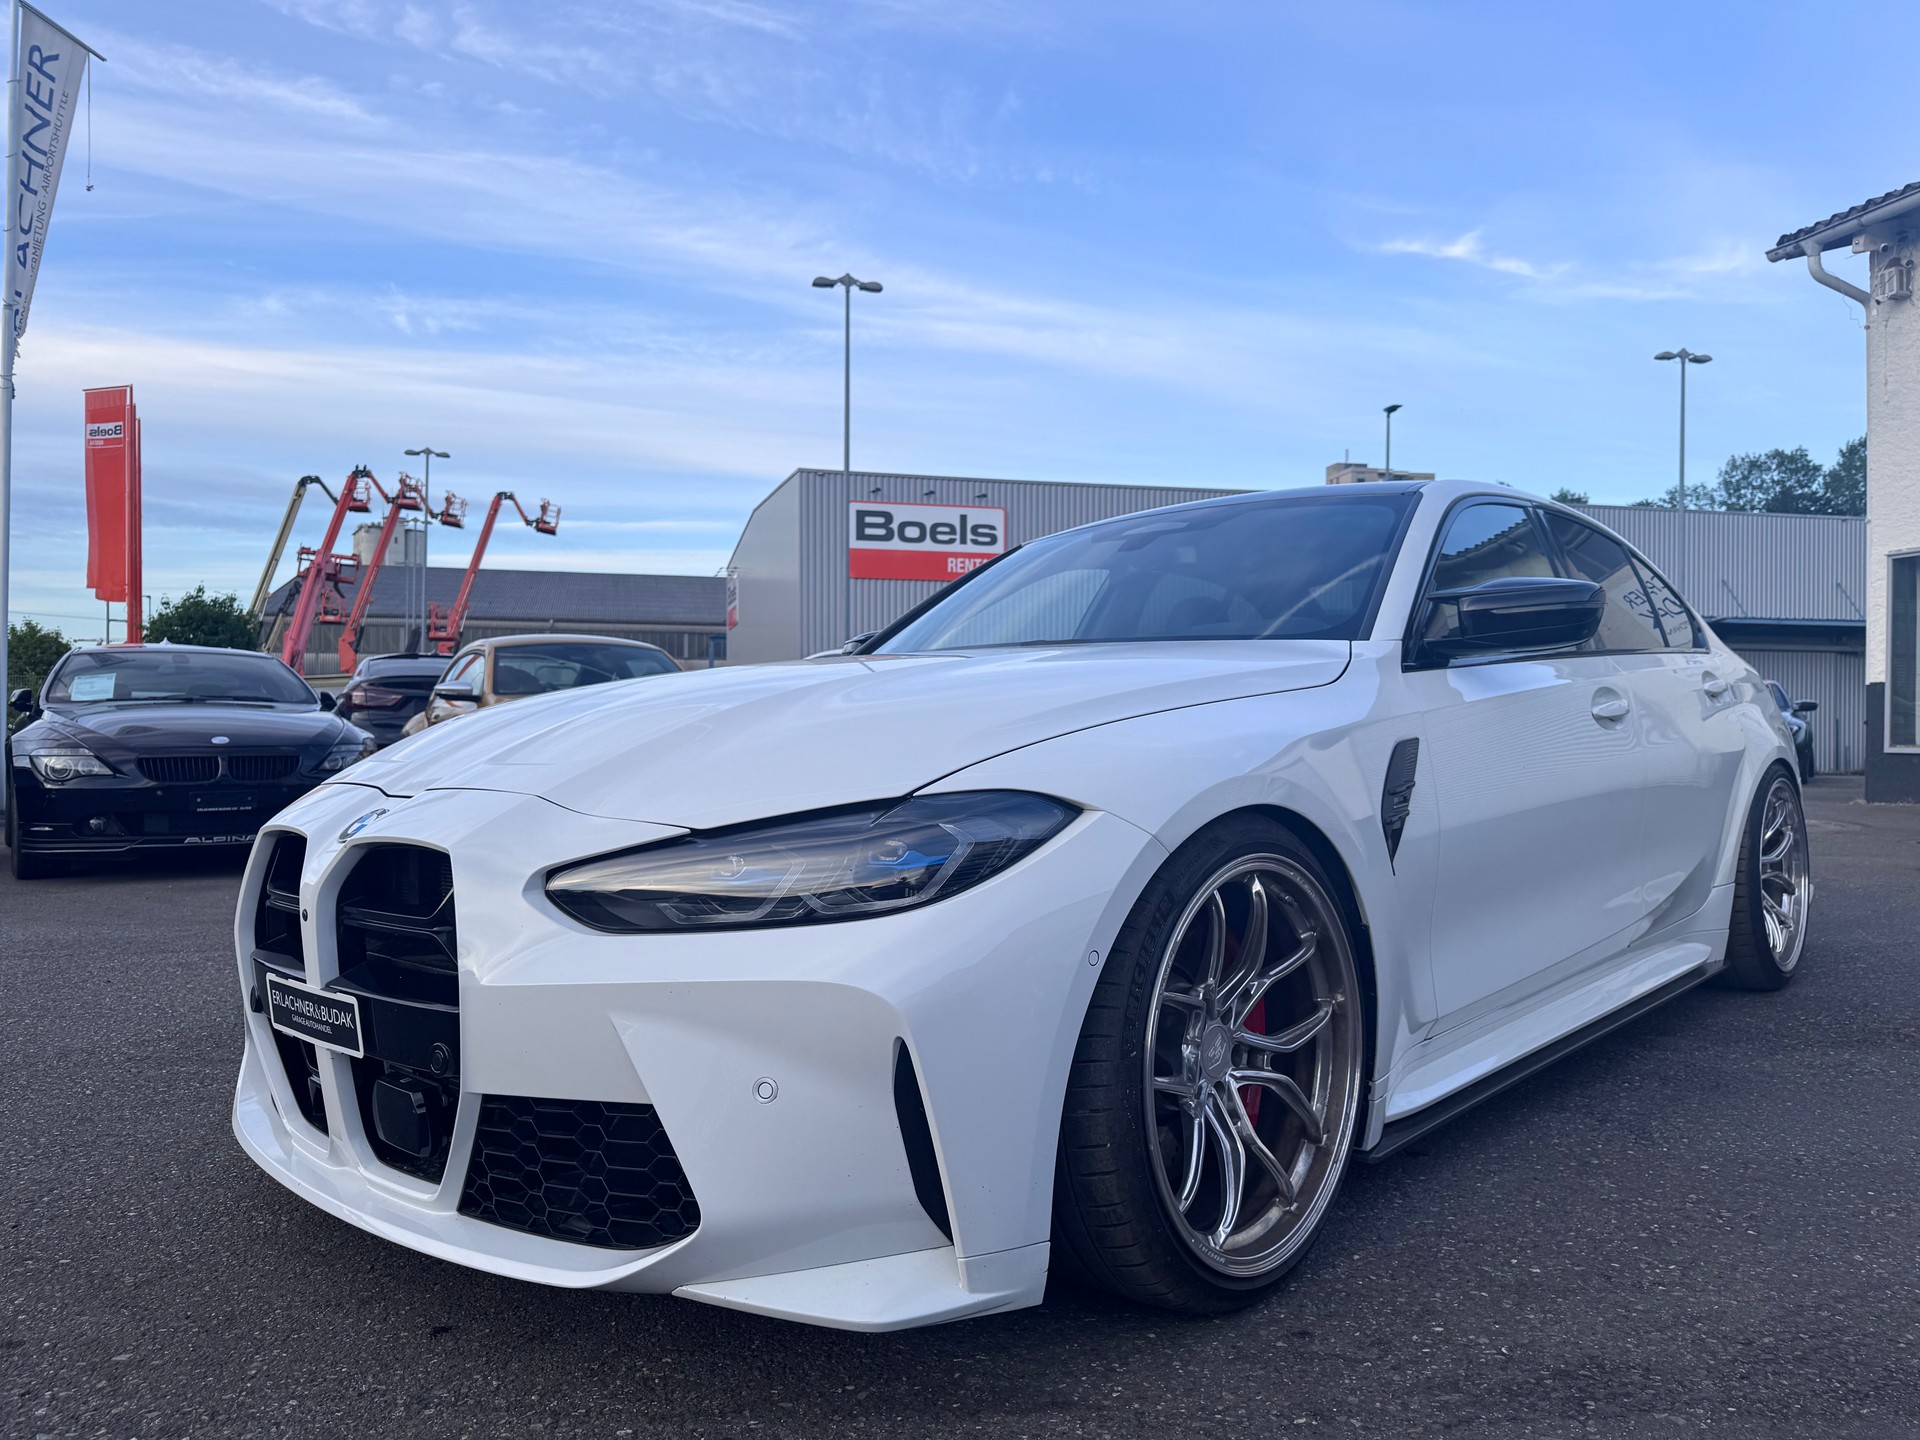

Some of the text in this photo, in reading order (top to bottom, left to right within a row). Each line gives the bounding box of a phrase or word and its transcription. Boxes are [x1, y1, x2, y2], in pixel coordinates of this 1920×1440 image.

[42, 91, 70, 195] AIRPORTSHUTTLE
[855, 509, 998, 547] Boels
[947, 557, 988, 573] RENT
